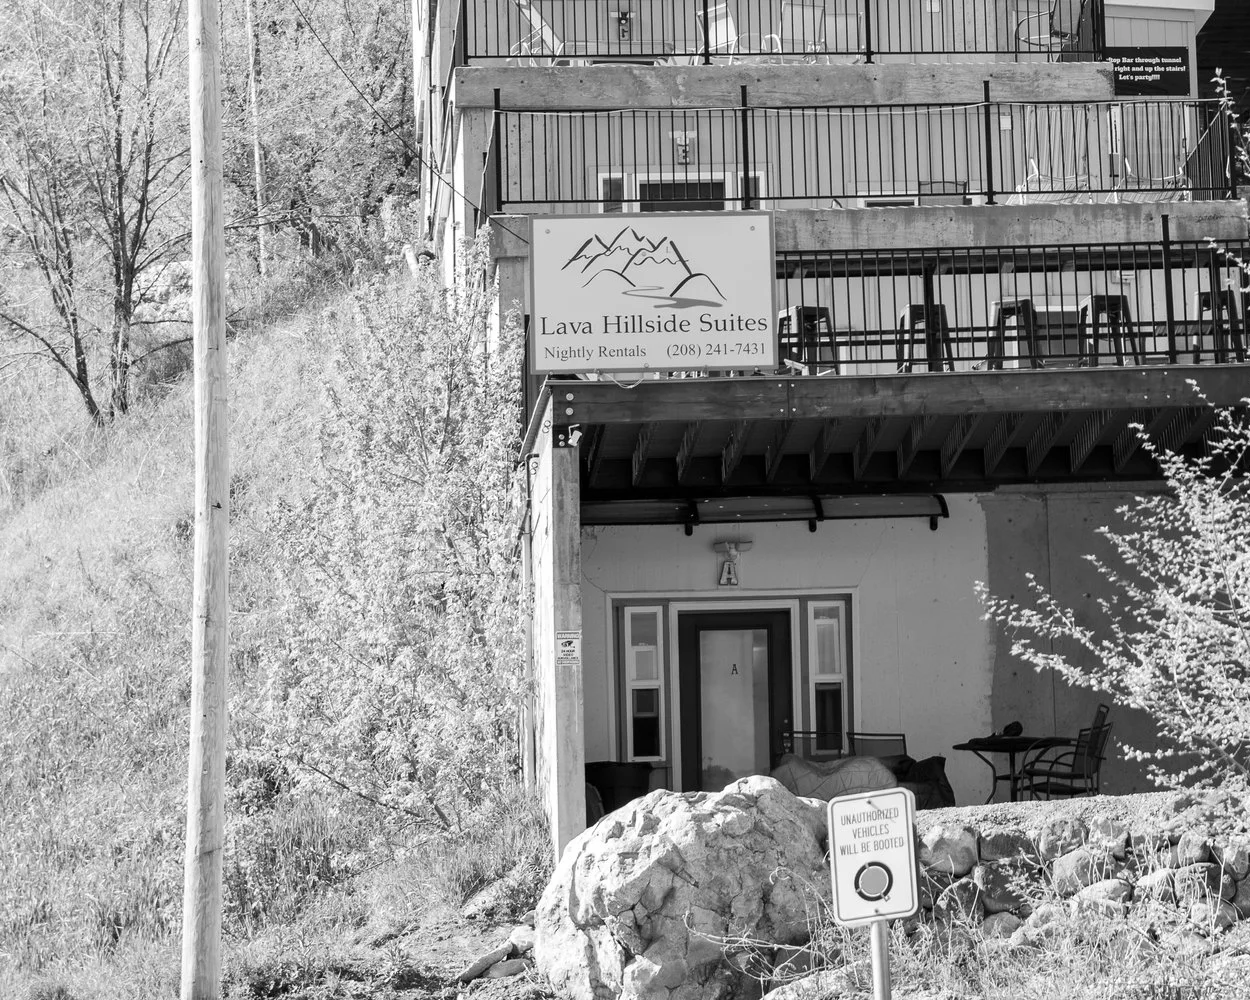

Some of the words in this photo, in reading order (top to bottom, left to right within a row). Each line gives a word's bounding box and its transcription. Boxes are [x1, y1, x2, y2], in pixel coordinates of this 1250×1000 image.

[541, 316, 593, 335] Lava
[602, 314, 691, 334] Hillside
[700, 313, 768, 333] Suites
[545, 346, 593, 361] Nightly
[599, 345, 647, 358] Rentals
[667, 343, 702, 359] (208)
[705, 343, 766, 356] 241-7431
[719, 560, 738, 586] A
[731, 664, 738, 674] A
[840, 807, 899, 826] UNAUTHORIZED
[852, 824, 890, 839] VEHICLES
[840, 844, 858, 856] WILL
[861, 842, 872, 853] BE
[874, 836, 904, 851] BOOTED
